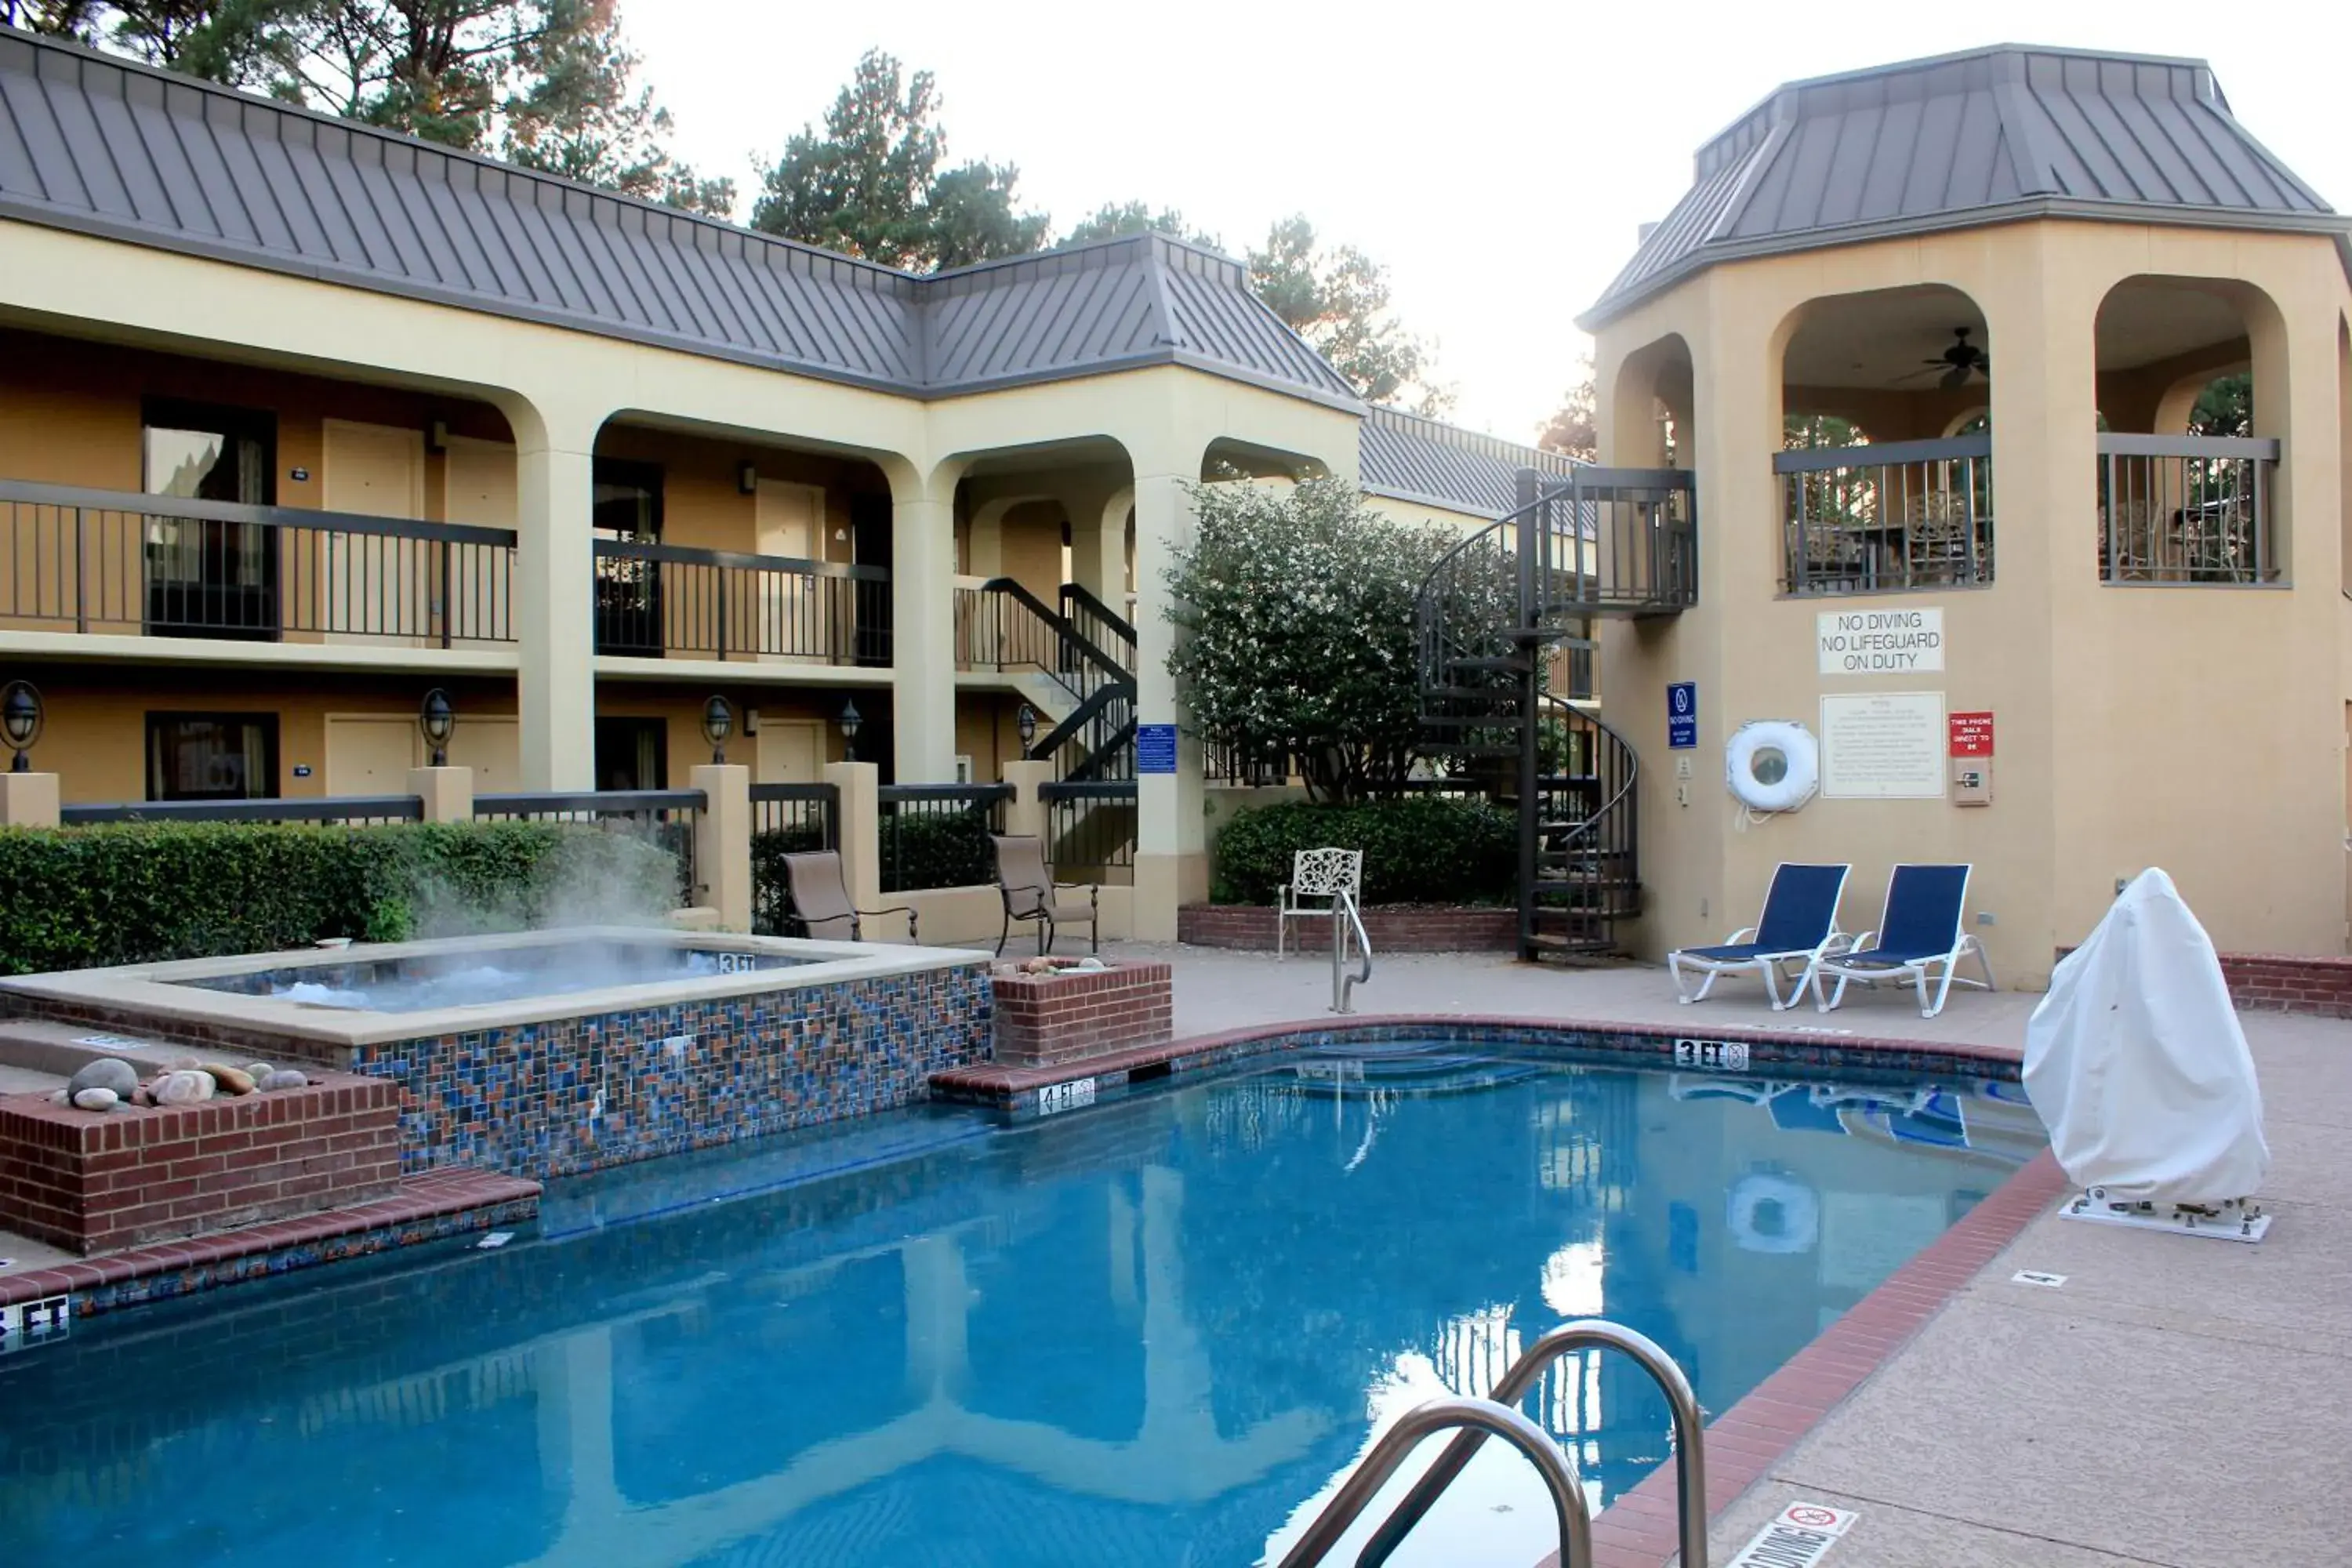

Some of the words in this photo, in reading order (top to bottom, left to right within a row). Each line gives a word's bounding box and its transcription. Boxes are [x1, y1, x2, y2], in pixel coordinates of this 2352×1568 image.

[1838, 615, 1863, 631] NO
[1867, 612, 1922, 630] DIVING
[1821, 636, 1846, 652] NO
[1850, 632, 1940, 651] LIFEGUARD
[1844, 655, 1868, 670] ON
[1873, 653, 1918, 669] DUTY
[22, 1297, 67, 1332] FT
